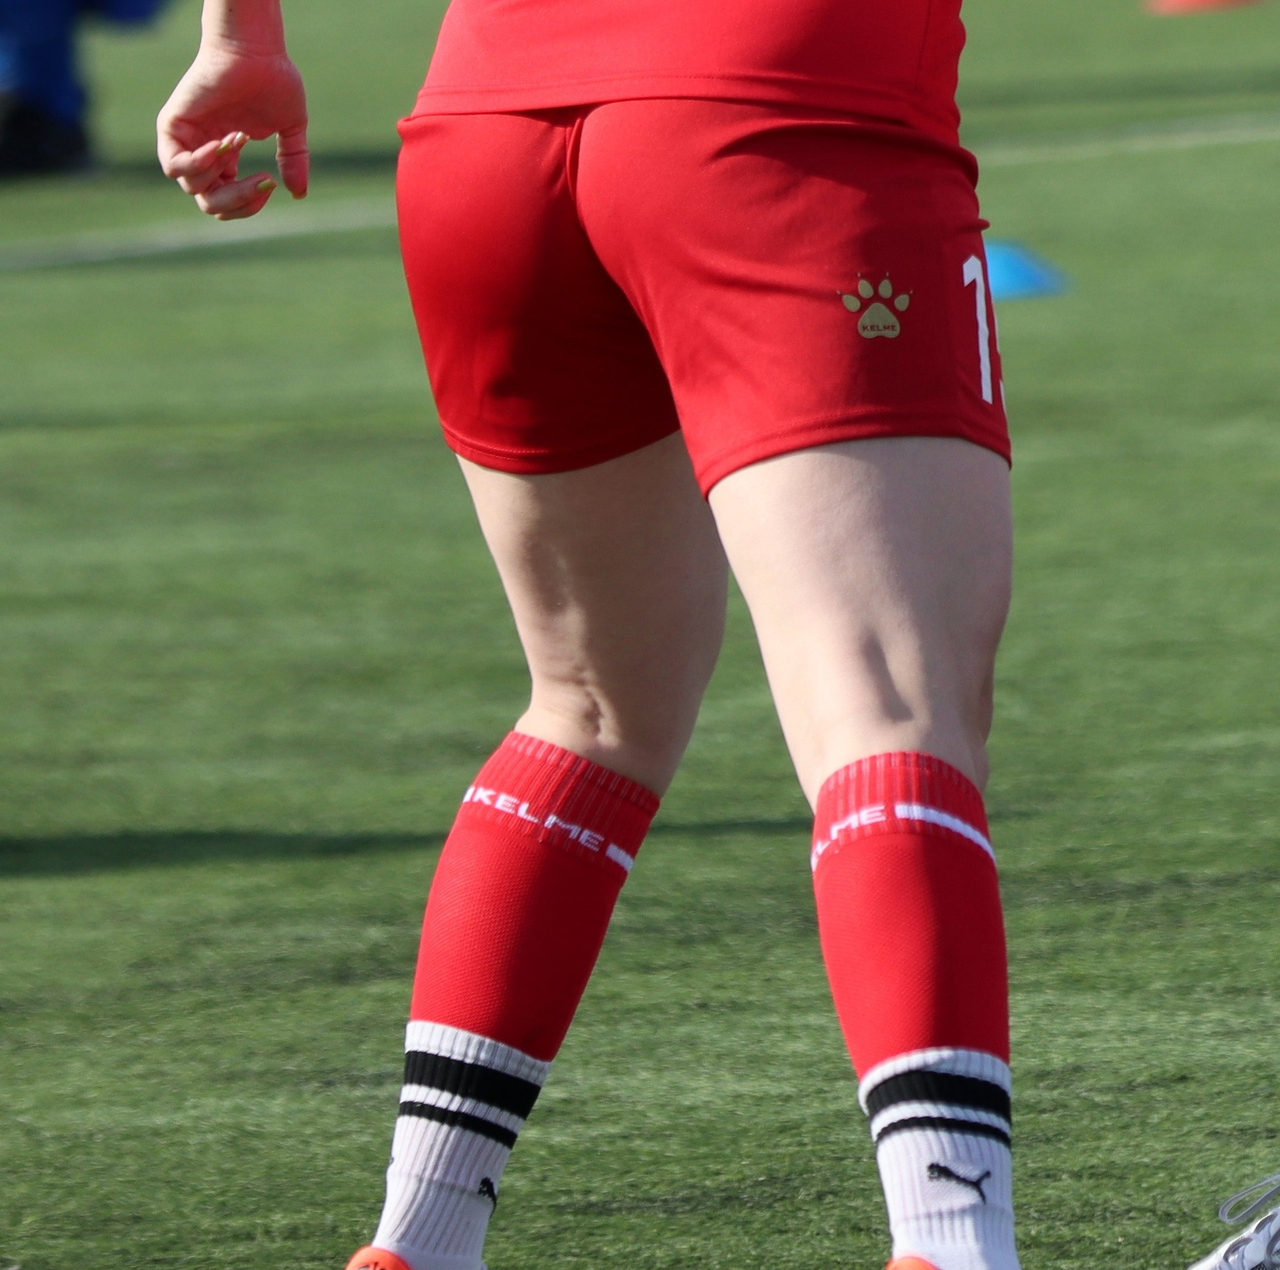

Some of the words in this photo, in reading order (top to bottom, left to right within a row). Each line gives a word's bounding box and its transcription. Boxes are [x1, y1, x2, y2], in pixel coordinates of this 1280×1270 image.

[862, 324, 897, 332] KELME
[962, 255, 1001, 407] 1
[472, 786, 605, 852] KELME
